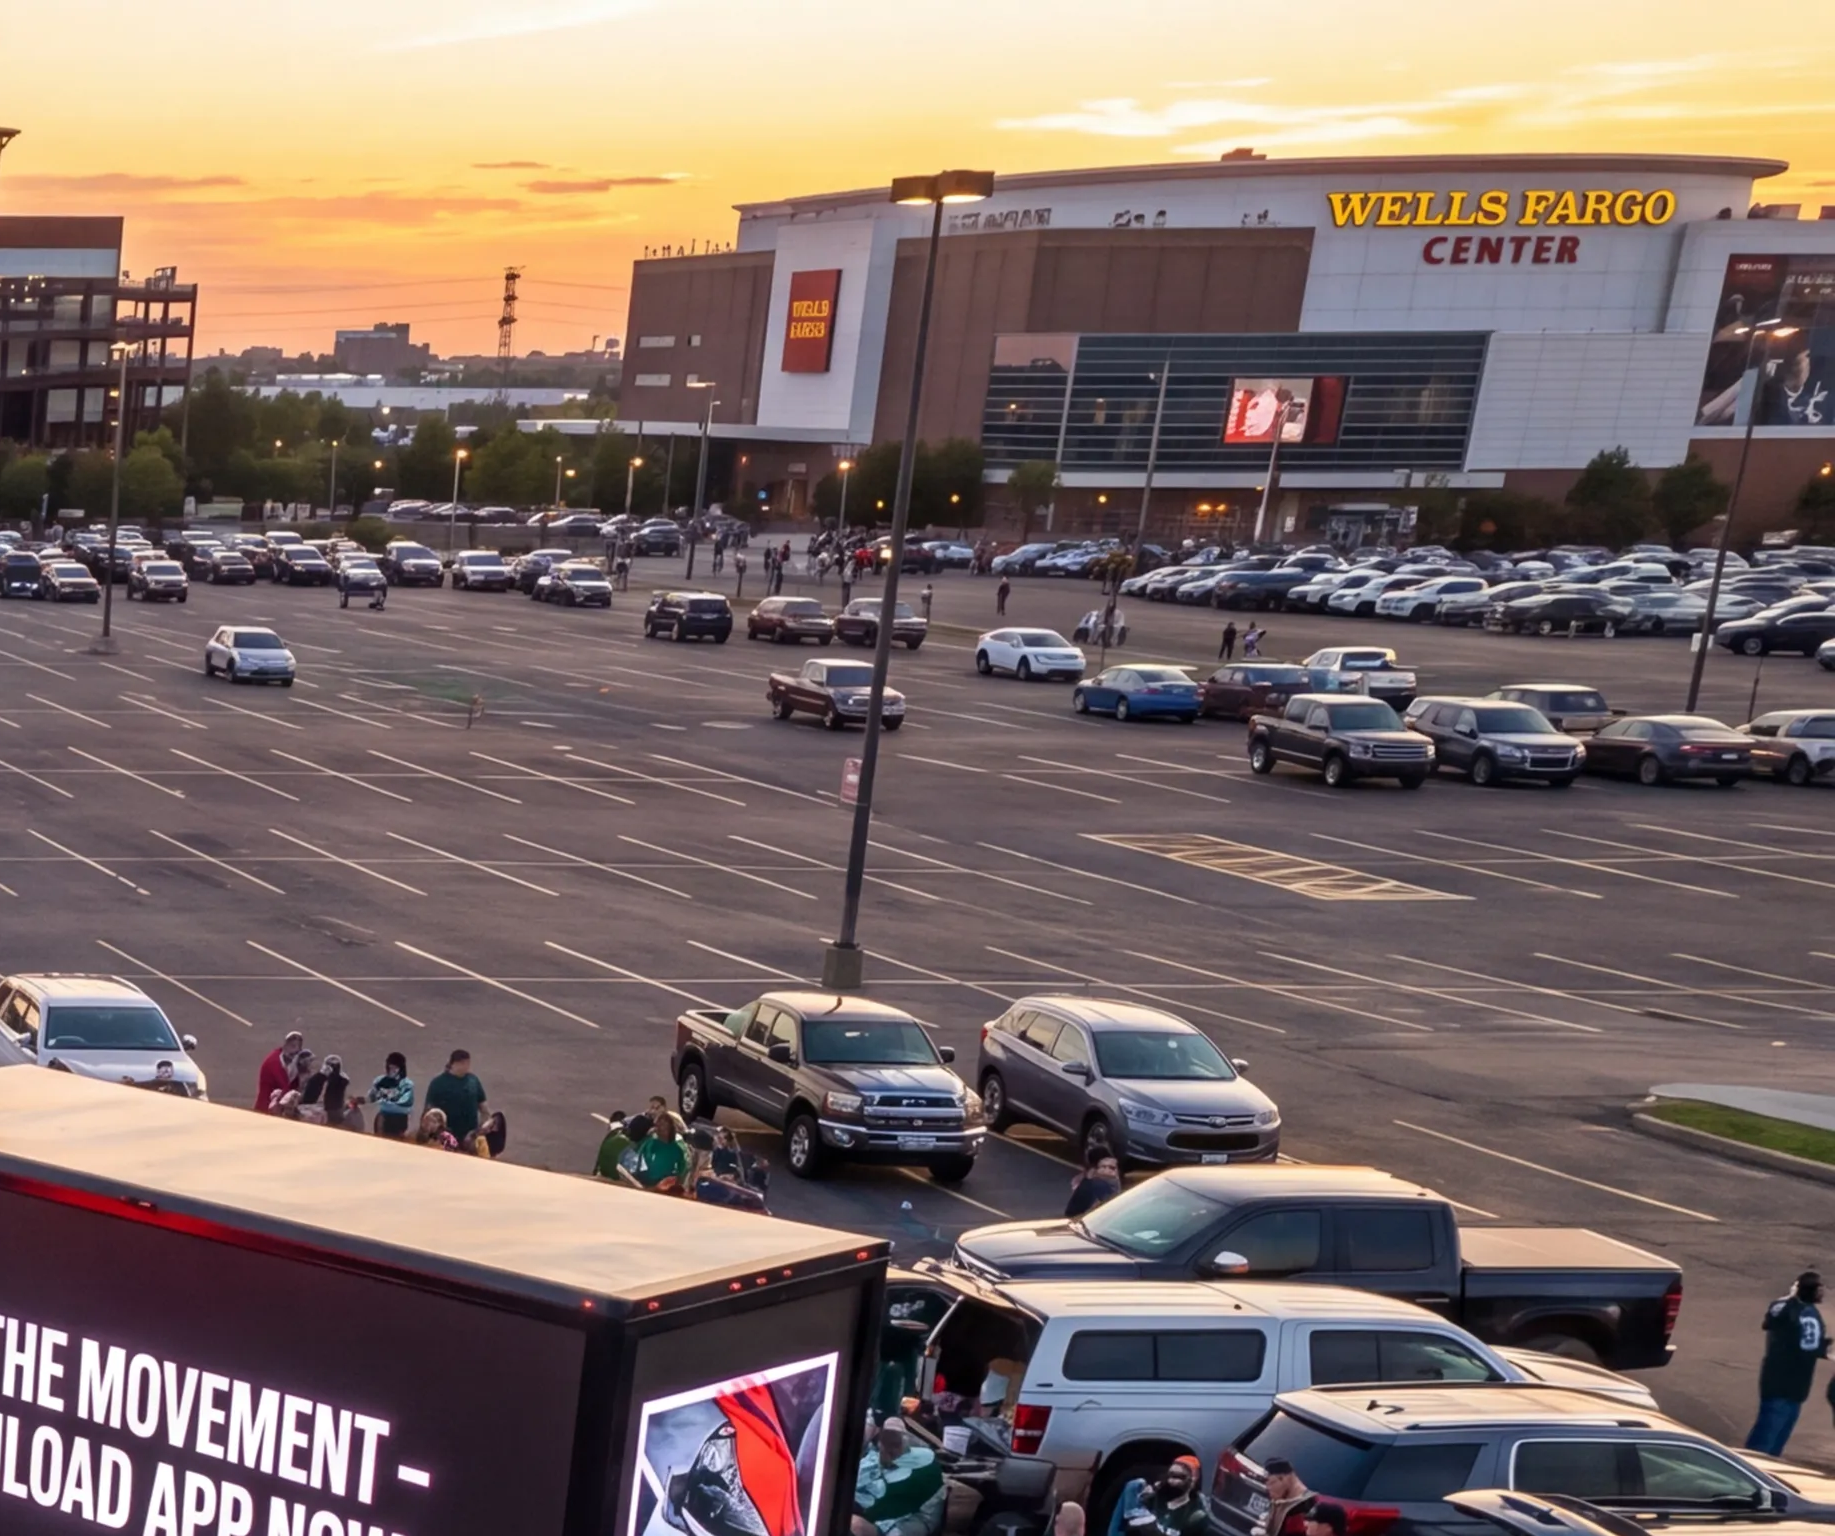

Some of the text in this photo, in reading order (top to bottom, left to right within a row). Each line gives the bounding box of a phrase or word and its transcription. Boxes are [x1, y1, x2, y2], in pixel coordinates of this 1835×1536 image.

[1327, 189, 1675, 227] WELLS FARGO
[1423, 235, 1580, 266] CENTER
[77, 1337, 390, 1505] MOVEMENT
